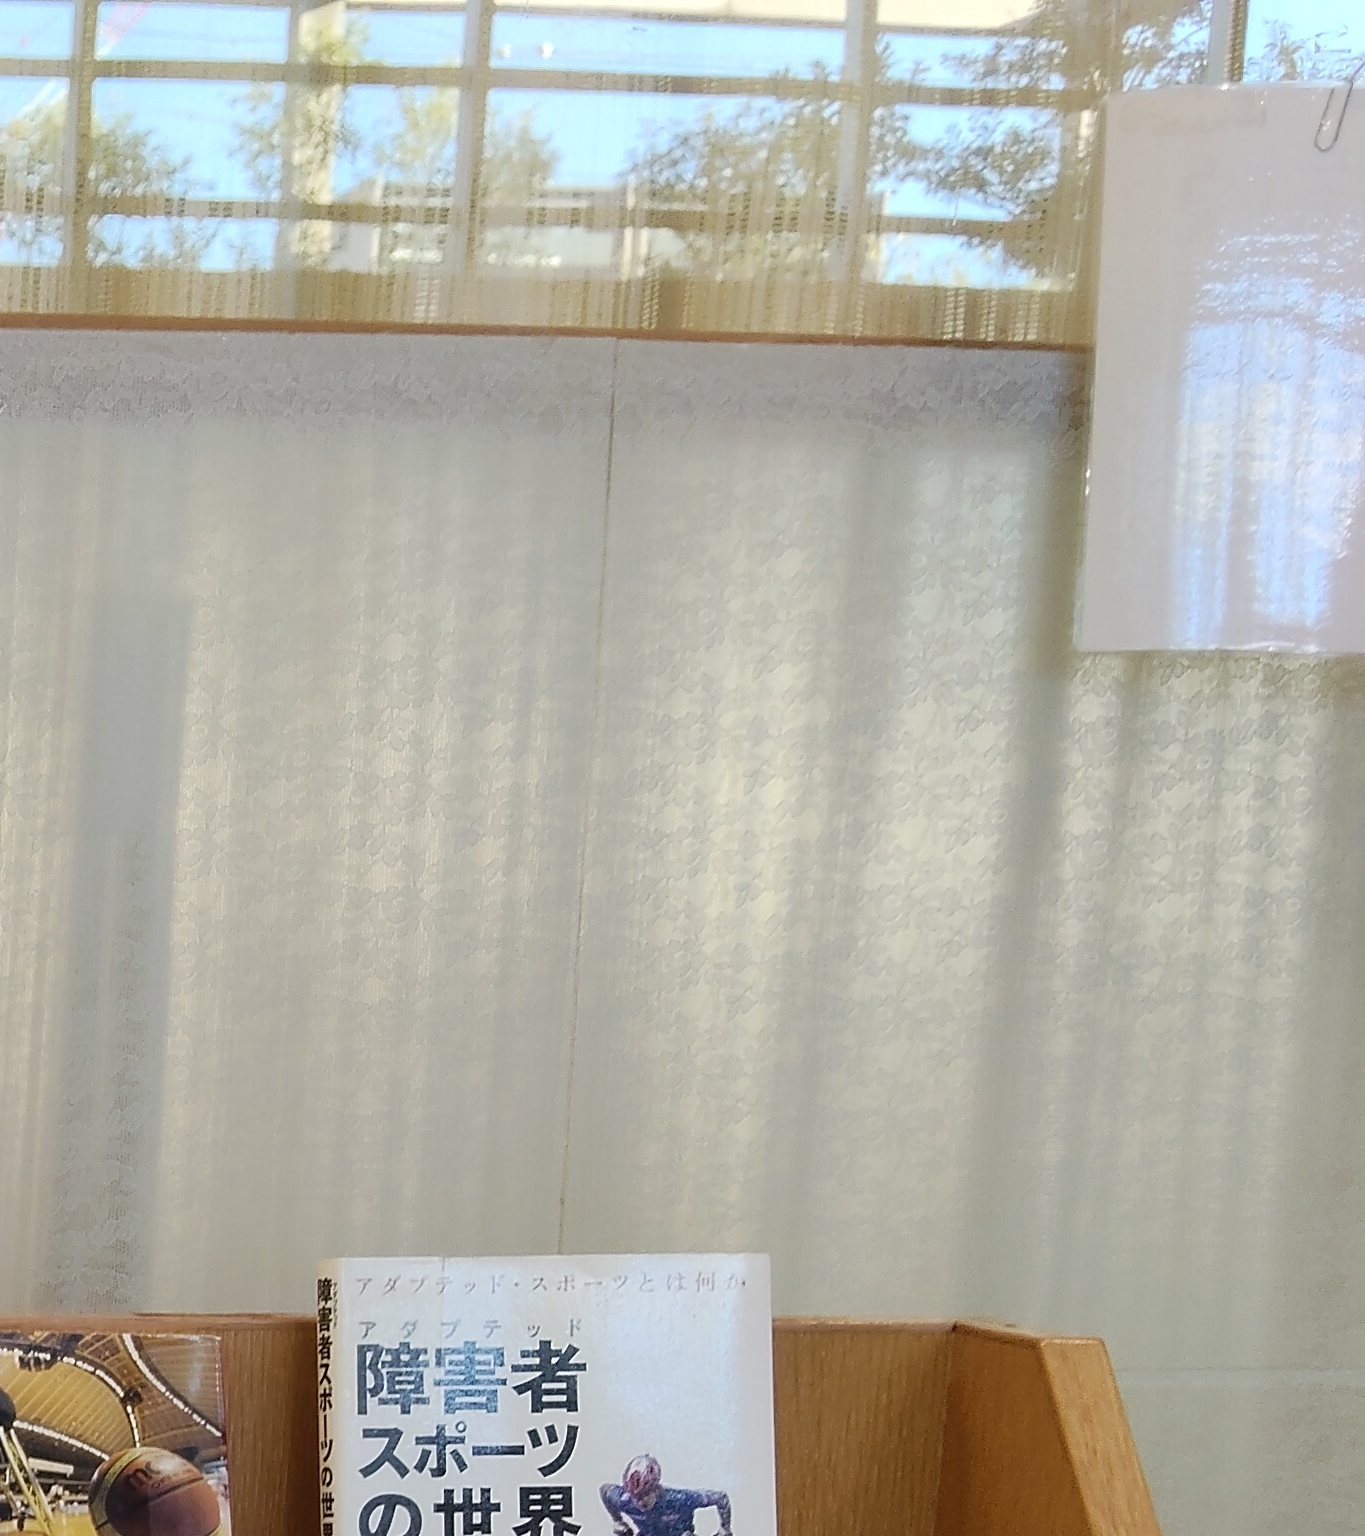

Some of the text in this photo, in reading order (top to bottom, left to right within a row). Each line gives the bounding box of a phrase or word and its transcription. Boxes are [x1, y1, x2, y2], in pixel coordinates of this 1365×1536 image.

[360, 1318, 583, 1338] アダプテッド
[356, 1340, 587, 1416] 障害者
[357, 1421, 581, 1479] スポーツ
